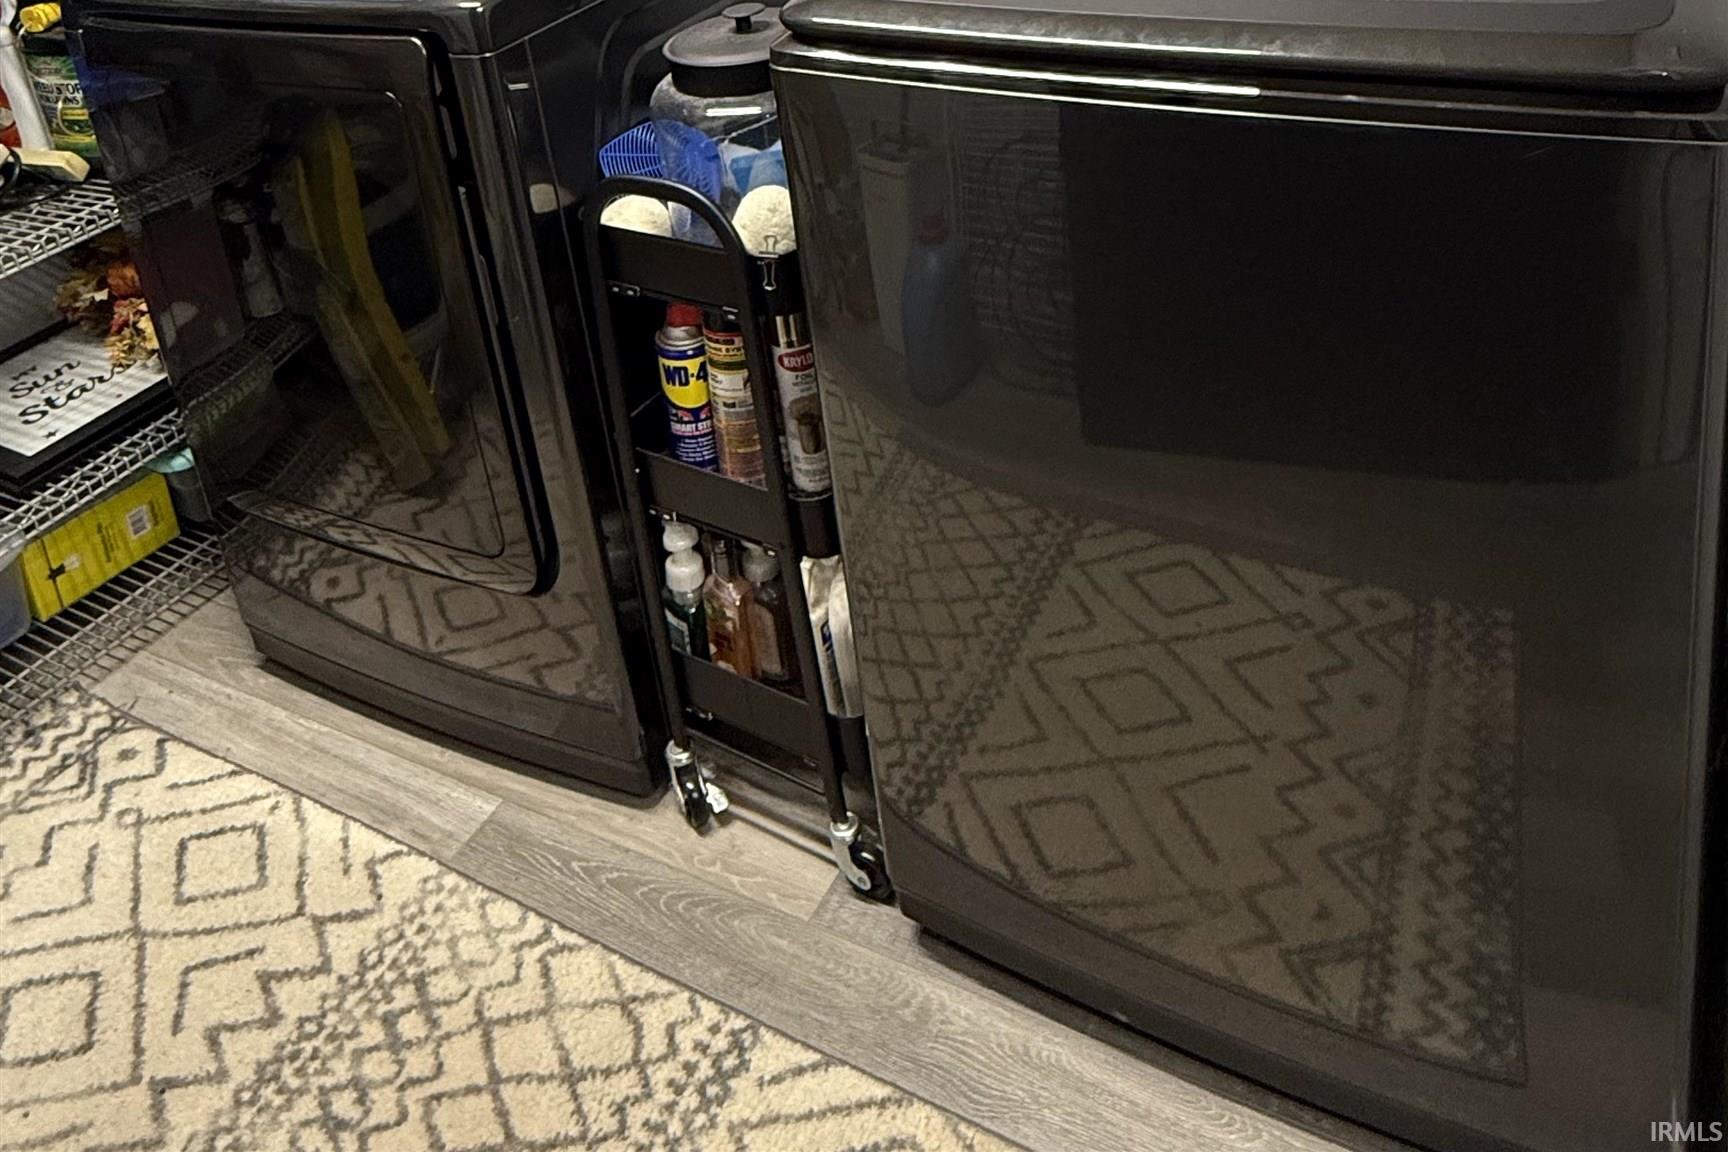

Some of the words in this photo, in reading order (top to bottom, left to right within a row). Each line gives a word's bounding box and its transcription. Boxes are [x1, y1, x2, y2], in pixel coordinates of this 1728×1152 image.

[662, 360, 708, 387] WD-4
[783, 352, 813, 369] KRYLO
[9, 360, 81, 399] Sun
